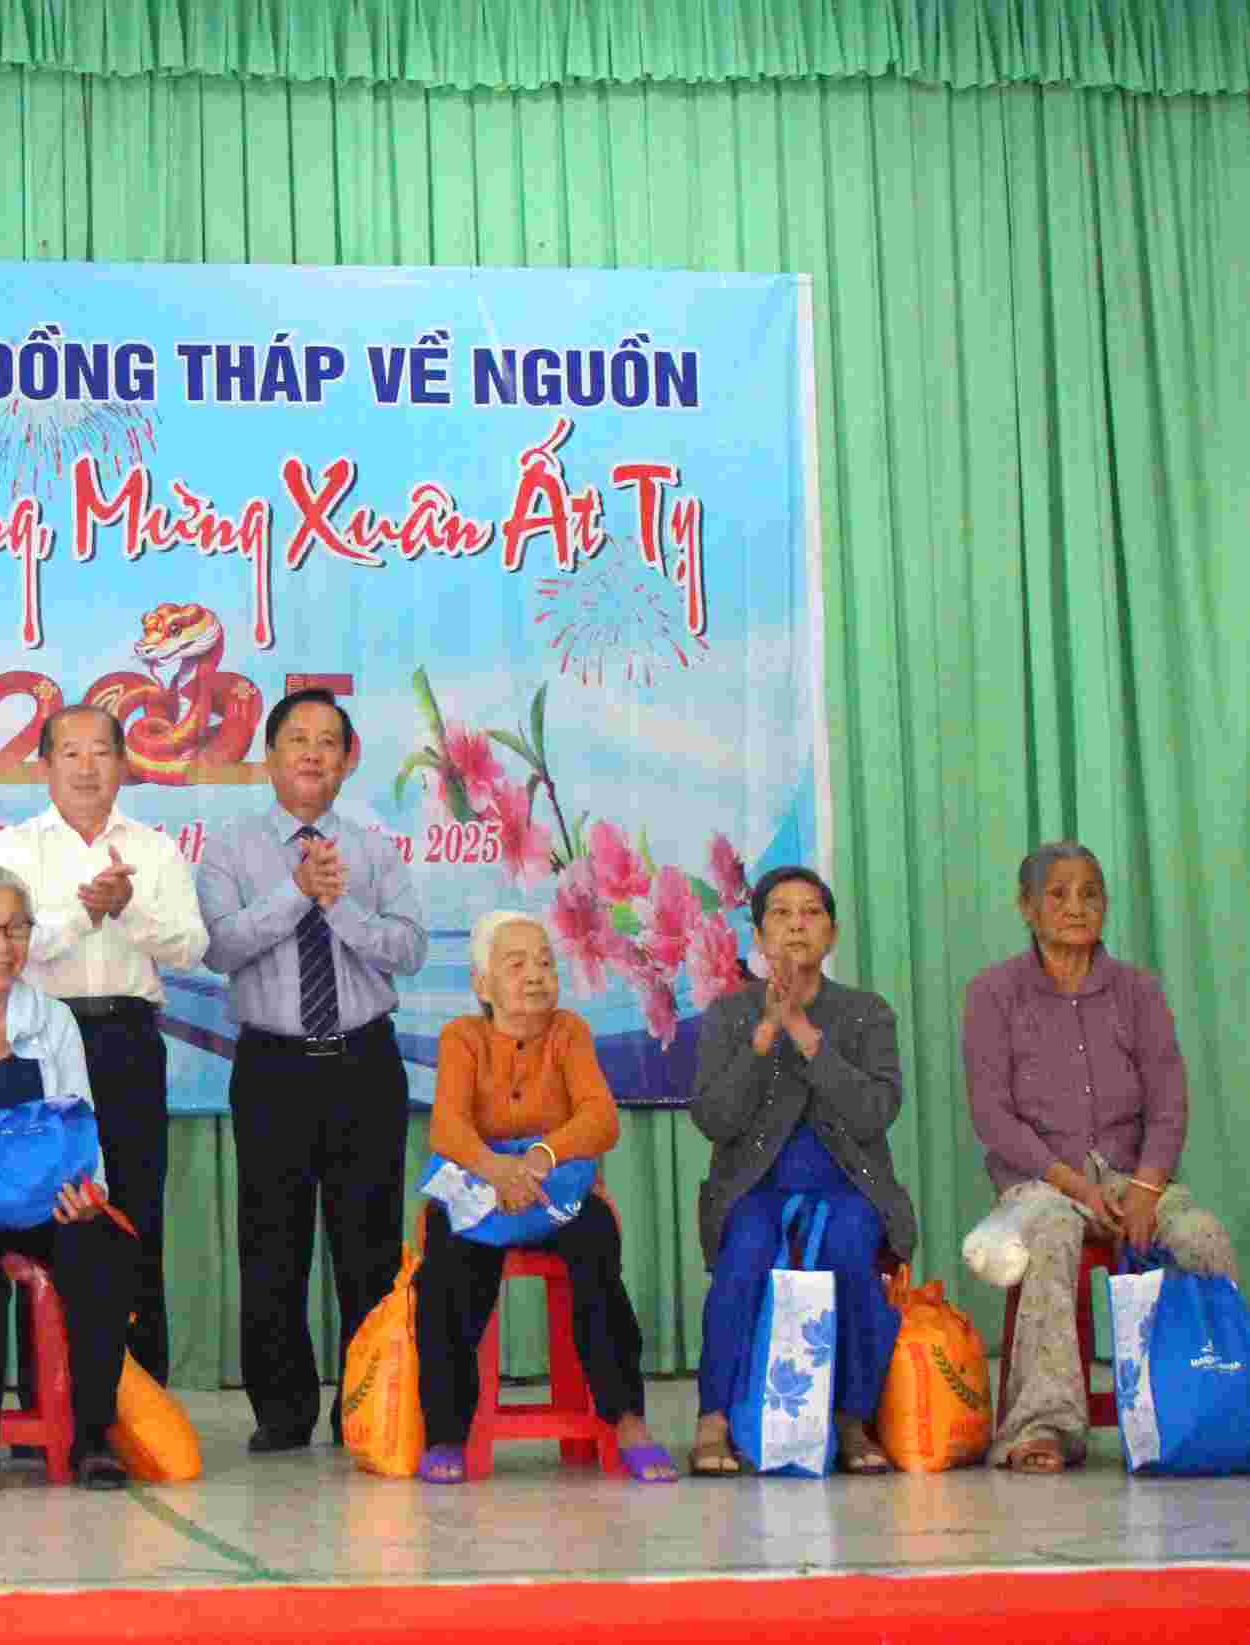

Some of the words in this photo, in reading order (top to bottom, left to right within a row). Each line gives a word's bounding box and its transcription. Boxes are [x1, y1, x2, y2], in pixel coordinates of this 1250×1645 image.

[177, 335, 345, 402] THÁP
[368, 330, 451, 404] VỀ
[473, 332, 699, 409] NGUỒN
[75, 457, 271, 646] Mừng
[282, 457, 492, 566] Xuân
[502, 418, 603, 568] Ất
[612, 463, 701, 631] Tỵ
[425, 823, 501, 864] 2025
